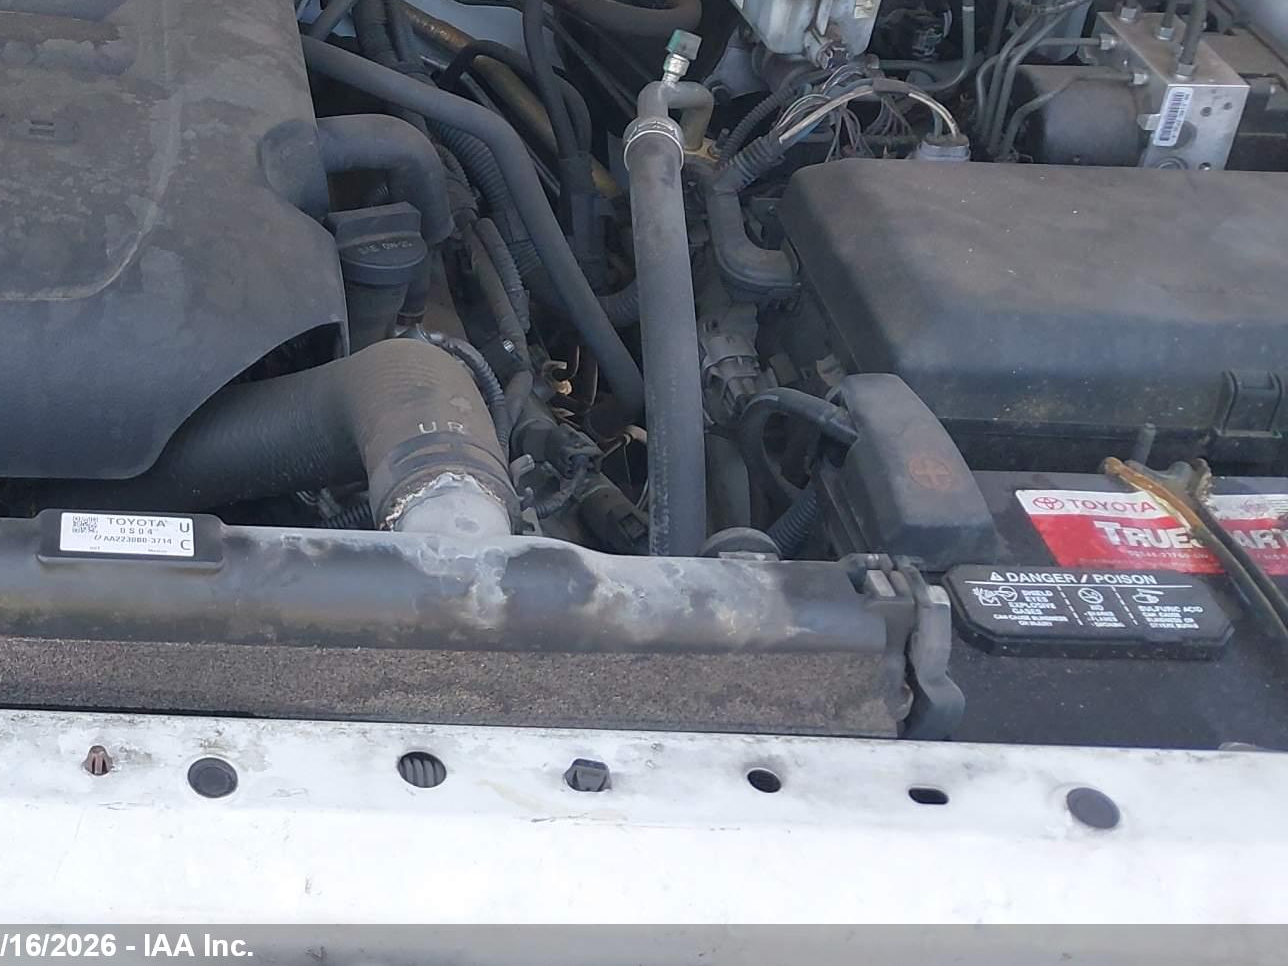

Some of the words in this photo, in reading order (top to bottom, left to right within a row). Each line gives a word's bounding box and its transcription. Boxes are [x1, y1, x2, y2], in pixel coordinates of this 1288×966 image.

[1066, 498, 1156, 513] TOYOTA
[107, 517, 166, 527] TOYOTA
[179, 522, 190, 533] U
[180, 539, 191, 550] C
[1006, 572, 1078, 583] DANGER
[1092, 574, 1158, 585] POISON
